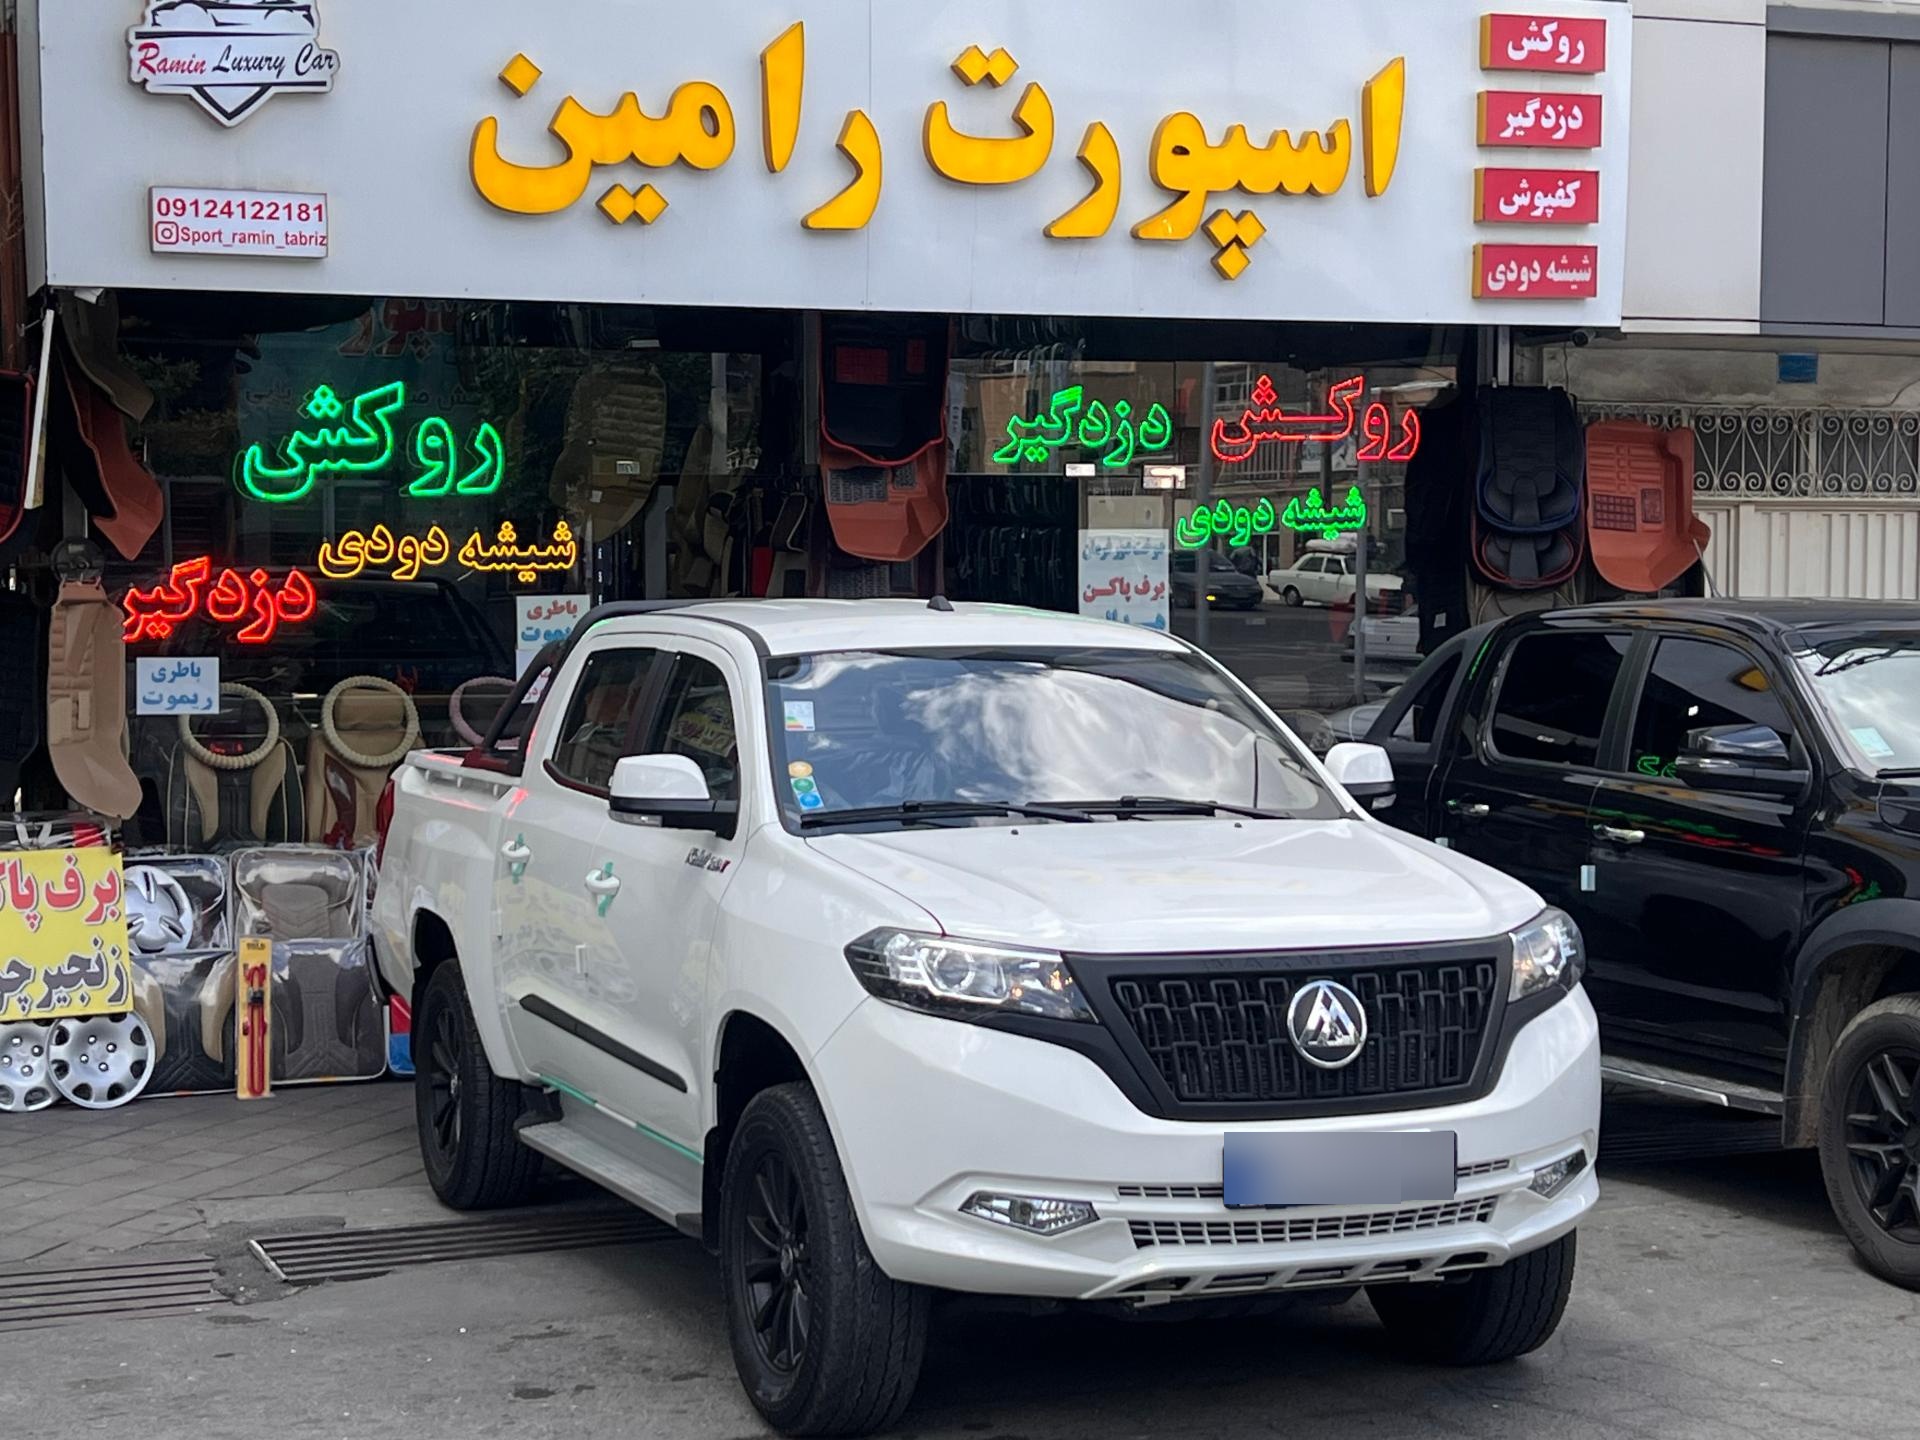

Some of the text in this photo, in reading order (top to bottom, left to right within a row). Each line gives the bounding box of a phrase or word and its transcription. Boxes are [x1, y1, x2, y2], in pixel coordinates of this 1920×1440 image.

[137, 42, 335, 79] Ramin Luxury Car
[1507, 20, 1585, 64] روکش
[1499, 97, 1583, 139] دزدگیر
[468, 20, 1406, 281] اسپورت رامین
[156, 198, 324, 222] 09124122181
[1499, 178, 1581, 218] کفپوش
[180, 226, 328, 249] Sport_ramin_tabriz
[1487, 254, 1592, 291] شیشه دودی
[993, 385, 1173, 467] دزدگیر
[1211, 373, 1421, 463] روکش
[242, 381, 505, 501] روکش
[1176, 485, 1367, 548] شیشه دودی
[318, 520, 578, 582] شیشه دودی
[121, 555, 317, 643] دزدگیر
[1133, 574, 1166, 601] برف
[527, 600, 578, 621] باطری
[151, 661, 202, 684] باطری
[142, 691, 213, 711] ریموت
[45, 855, 121, 924] برف
[36, 937, 127, 1009] زنجیر
